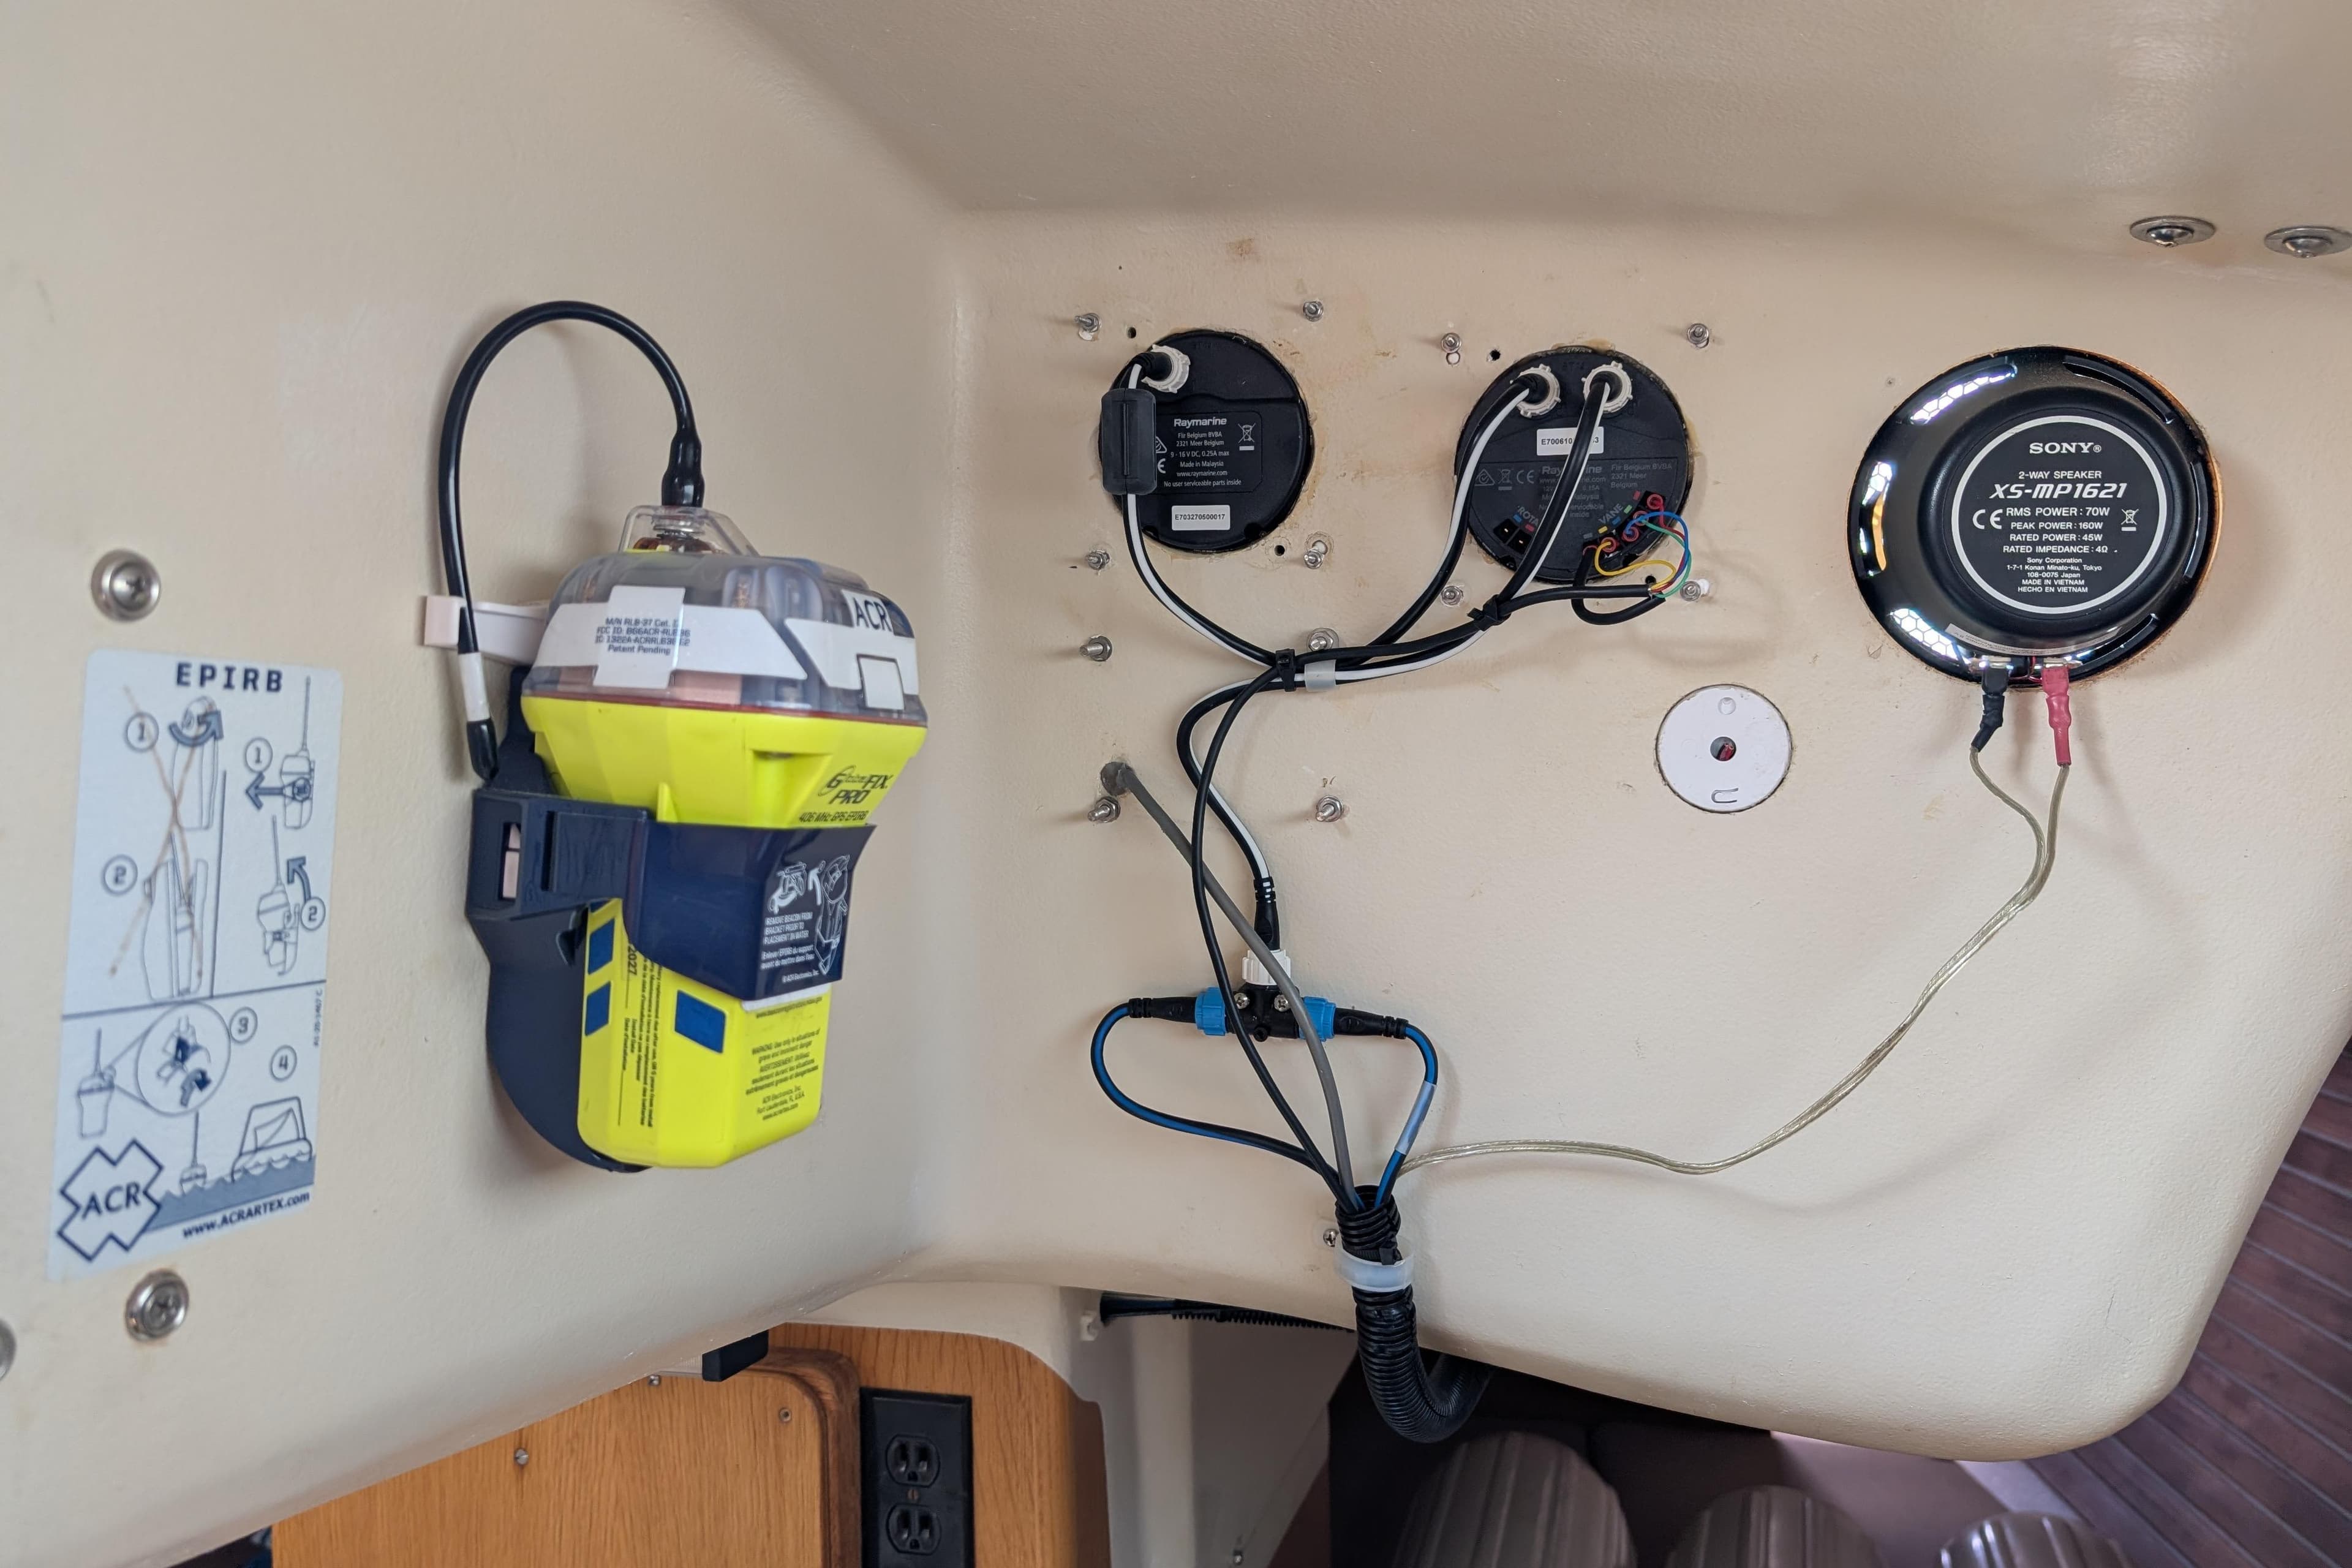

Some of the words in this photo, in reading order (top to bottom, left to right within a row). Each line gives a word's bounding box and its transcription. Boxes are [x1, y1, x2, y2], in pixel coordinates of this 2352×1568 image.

[1174, 417, 1227, 429] Raymarine
[1542, 465, 1602, 477] Rayine
[2018, 471, 2050, 480] 2-WAY
[2054, 470, 2102, 479] SPEAKER
[1989, 483, 2128, 499] XS-MP1621
[1598, 503, 1623, 524] VANE
[2006, 507, 2031, 516] RMS
[2086, 507, 2110, 516] 70W
[853, 597, 892, 632] ACR
[637, 645, 671, 655] Pending
[176, 662, 282, 693] EPIRB
[828, 789, 871, 804] PRO
[279, 1054, 288, 1071] 4
[81, 1180, 141, 1221] ACR
[183, 1193, 310, 1238] www.ACRARTEX.com
